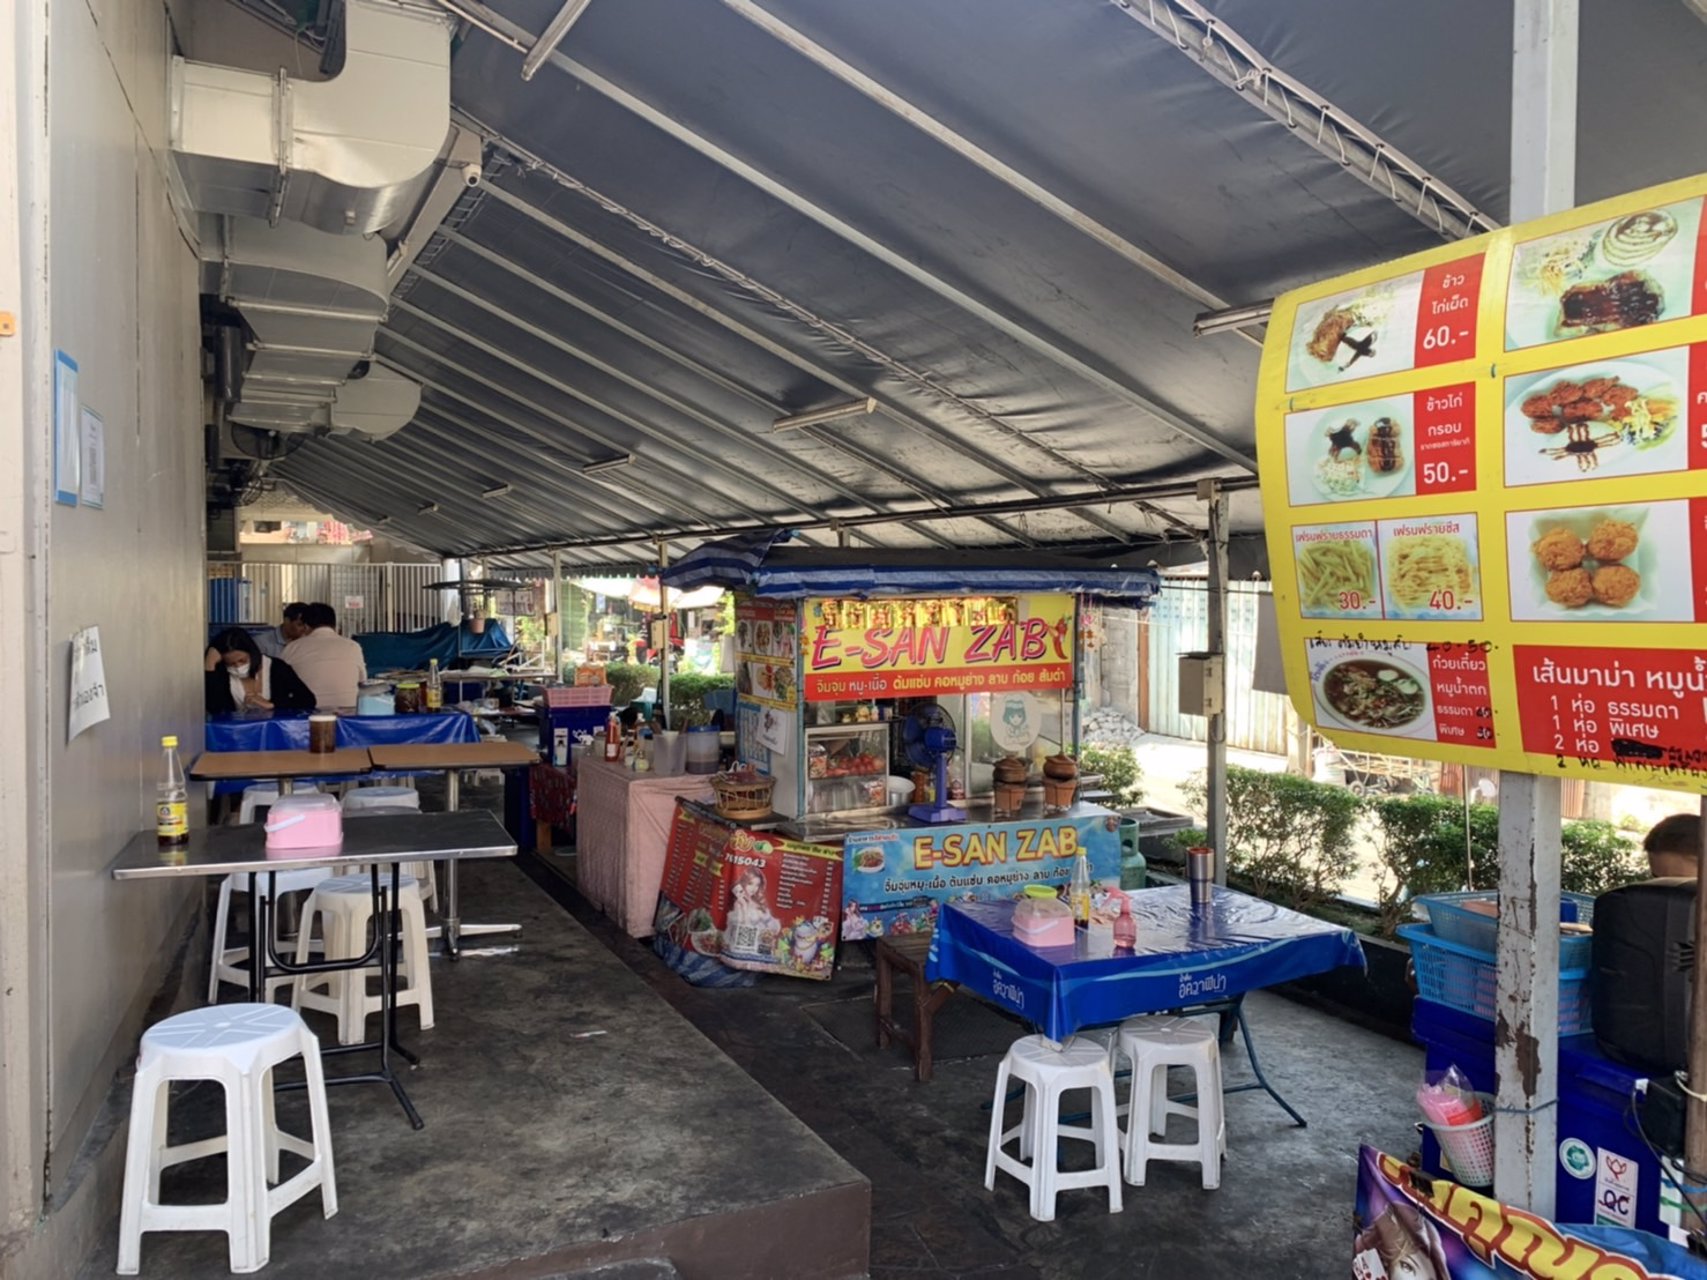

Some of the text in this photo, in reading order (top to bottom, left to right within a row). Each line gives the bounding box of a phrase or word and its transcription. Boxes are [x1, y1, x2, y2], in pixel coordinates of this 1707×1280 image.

[1442, 274, 1465, 289] ข้าว
[1423, 325, 1469, 349] 60.-
[1426, 391, 1463, 411] ข้าวไก่
[1428, 422, 1462, 437] กรอบ
[1423, 461, 1468, 484] 50.-
[1339, 591, 1376, 610] 30.-
[1429, 590, 1473, 610] 40.-
[811, 617, 1050, 670] E-SAN ZAB
[934, 671, 984, 691] คอหมูย่าง
[988, 673, 1008, 685] ลาบ
[1532, 657, 1635, 688] เส้นมาม่า
[1437, 676, 1487, 697] หมูน้ำตก
[1437, 705, 1473, 717] ธรรมดา
[1551, 693, 1680, 720] 1 ห่อ ธรรมดา
[1552, 713, 1659, 739] 1 ห่อ พิเศษ
[1554, 733, 1600, 753] 2 ห่อ
[913, 825, 1078, 869] E-SAN ZAB
[987, 869, 1029, 885] คอหมูย่าง
[1033, 869, 1050, 880] ลาบ
[1598, 1188, 1631, 1216] QC
